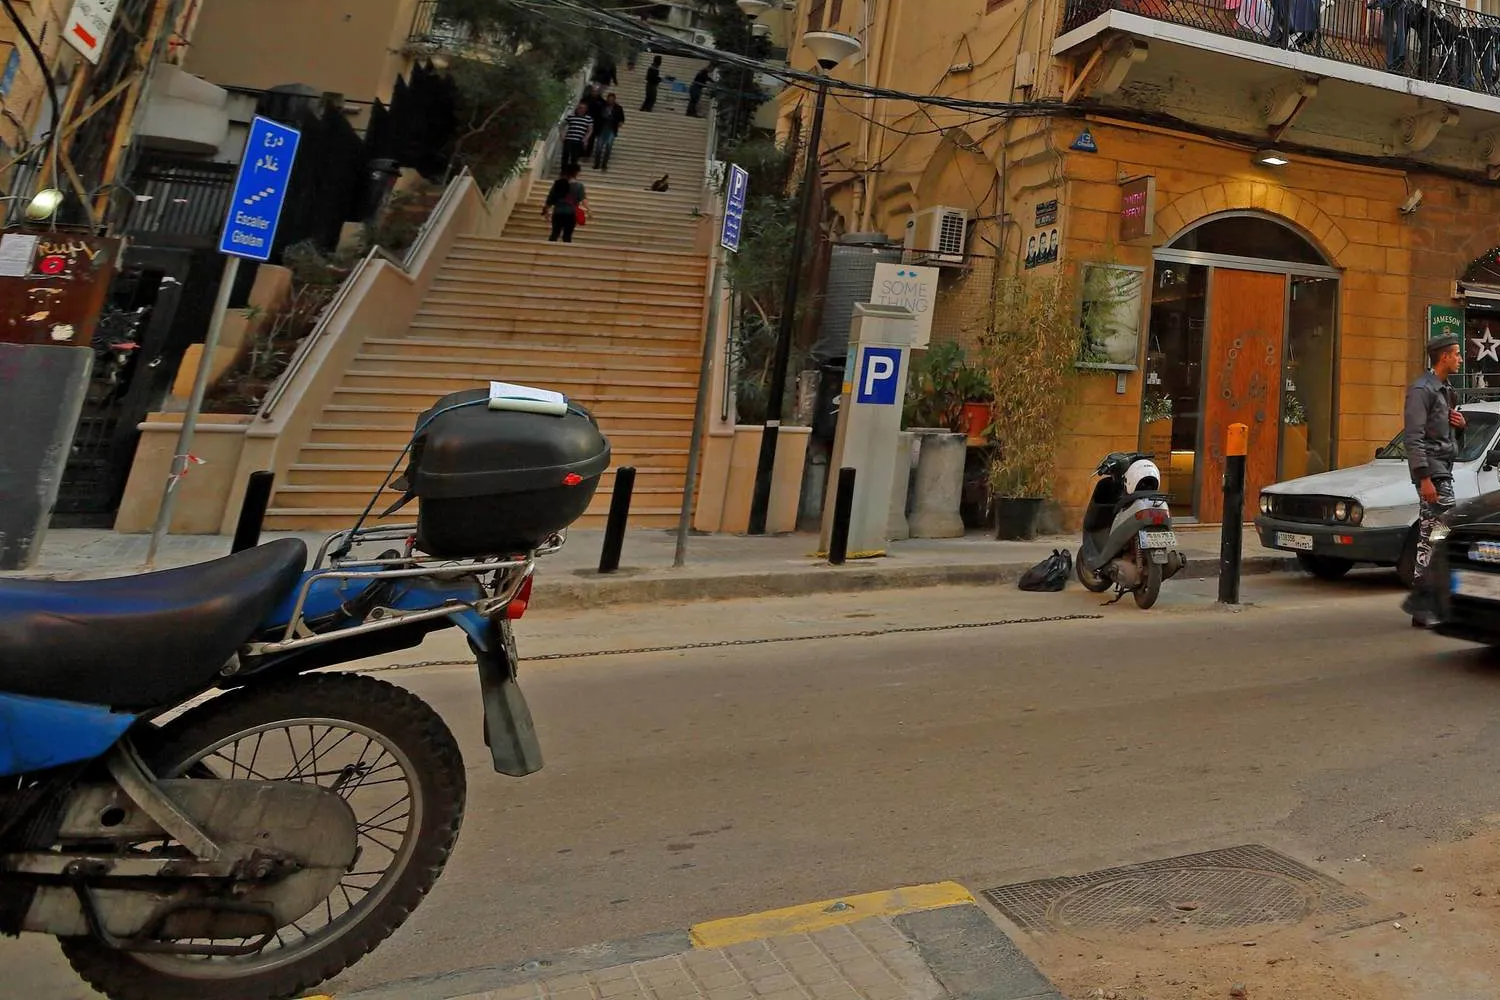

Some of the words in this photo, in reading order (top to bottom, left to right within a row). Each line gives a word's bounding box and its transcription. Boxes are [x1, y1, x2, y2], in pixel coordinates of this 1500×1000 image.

[263, 131, 284, 148] درج
[254, 154, 280, 174] غلام
[734, 172, 743, 195] P
[235, 211, 270, 230] Escalier
[231, 230, 264, 248] Gholam
[882, 280, 927, 297] SOME
[1432, 315, 1461, 326] JAMESON
[864, 355, 894, 396] P
